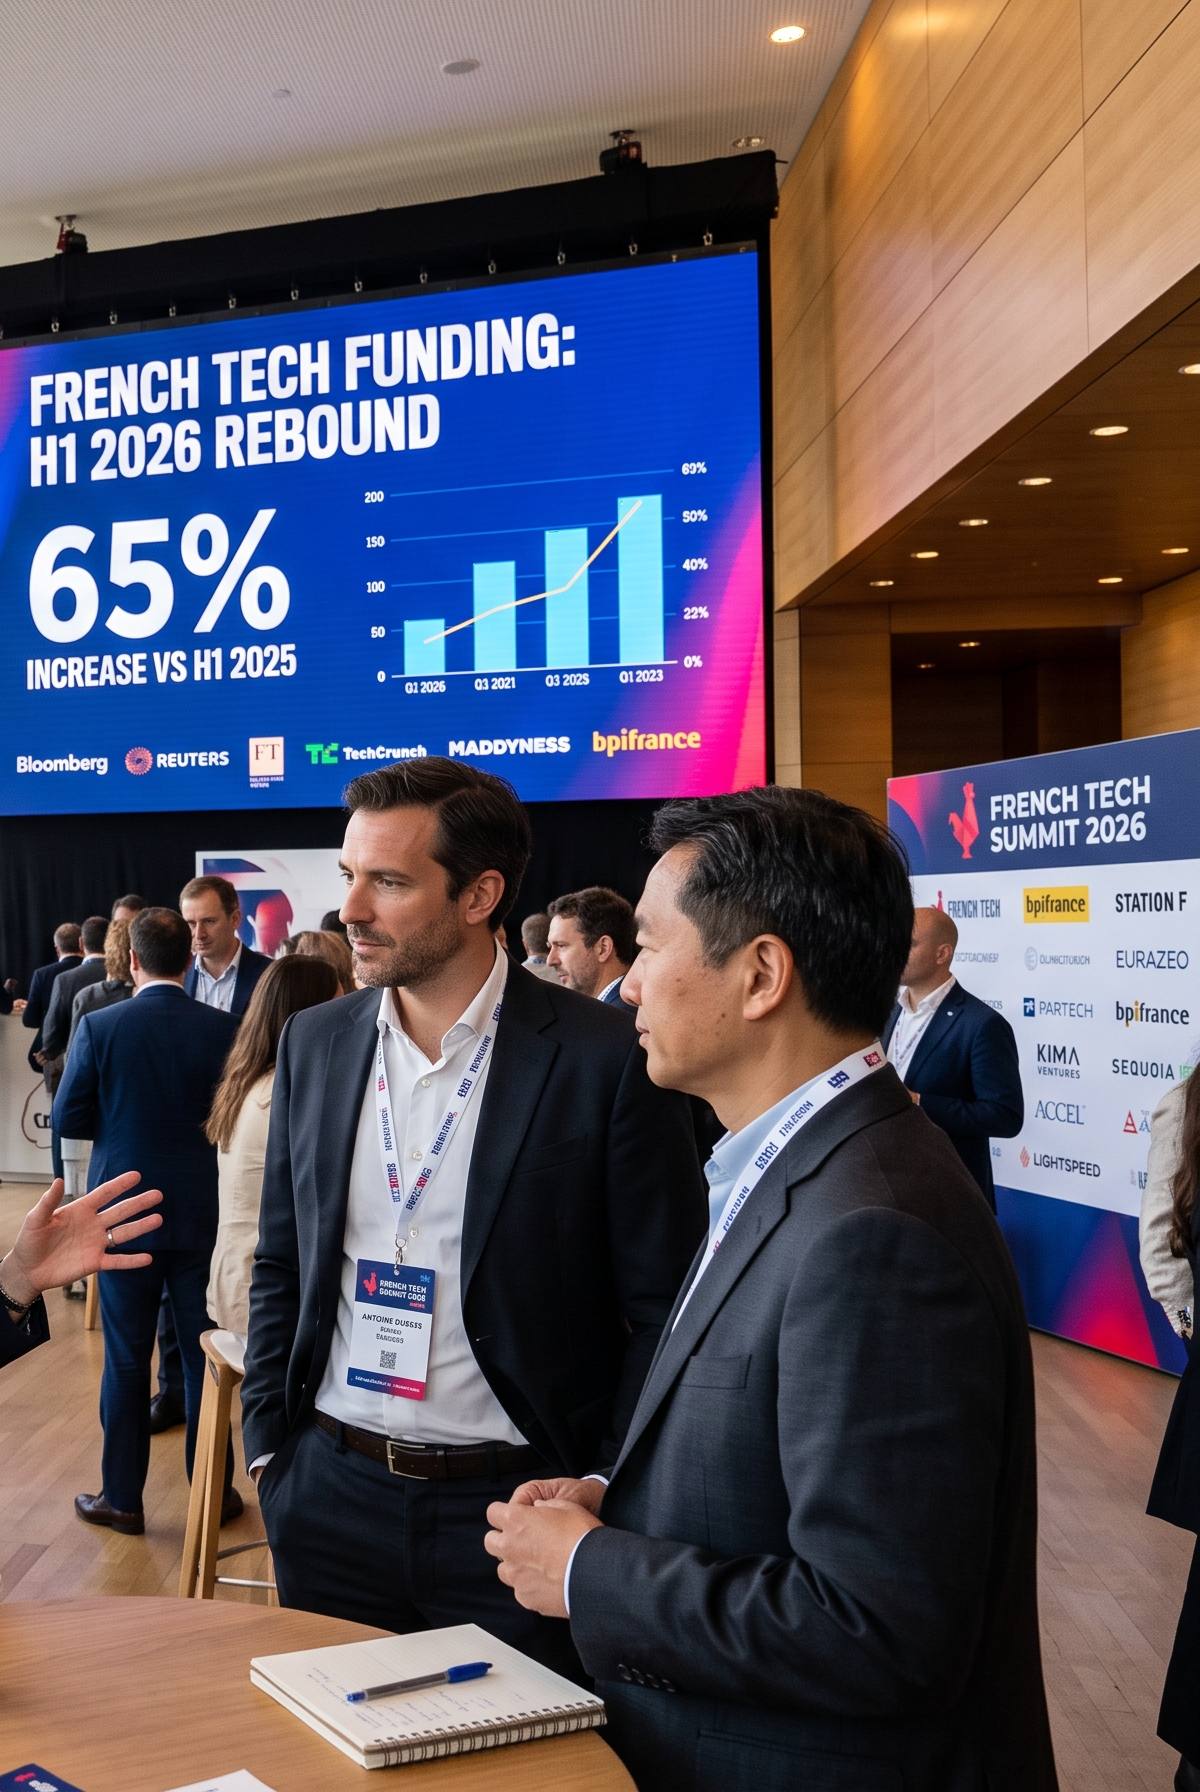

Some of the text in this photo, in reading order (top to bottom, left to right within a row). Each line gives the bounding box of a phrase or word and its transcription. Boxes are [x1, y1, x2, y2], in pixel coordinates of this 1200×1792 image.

[30, 312, 577, 427] FRENCH TECH FUNDING:
[30, 393, 441, 487] H1 2026 REBOUND
[364, 490, 385, 503] 200
[365, 534, 386, 549] 150
[682, 557, 709, 571] 40%
[28, 508, 291, 643] 65%
[365, 580, 386, 594] 100
[683, 605, 709, 620] 22%
[370, 625, 386, 639] 50
[26, 643, 297, 690] INCREASE VS H1 2025
[683, 655, 703, 669] 0%
[377, 670, 386, 683] 0
[491, 676, 516, 690] 2021
[636, 669, 664, 682] 2023
[420, 680, 447, 693] 2026
[255, 743, 281, 760] FT
[343, 743, 427, 761] TechCrunch
[448, 736, 571, 757] MADDYNESS
[592, 728, 702, 757] bpifrance
[16, 753, 108, 775] Bloomberg
[156, 751, 230, 769] REUTERS
[990, 774, 1151, 821] FRENCH TECH
[990, 811, 1147, 853] SUMMIT 2026
[980, 899, 1001, 918] TECH
[1026, 894, 1086, 918] bpifrance
[1115, 891, 1188, 913] STATION F
[1116, 950, 1189, 969] EURAZEO
[1039, 1001, 1094, 1018] PARTECH
[1115, 1000, 1190, 1027] bpifrance
[1037, 1043, 1080, 1066] KIMA
[1037, 1066, 1081, 1079] VENTURES
[1112, 1058, 1175, 1080] SEQUOIA
[1035, 1100, 1085, 1125] ACCEL
[1033, 1152, 1101, 1178] LIGHTSPEED
